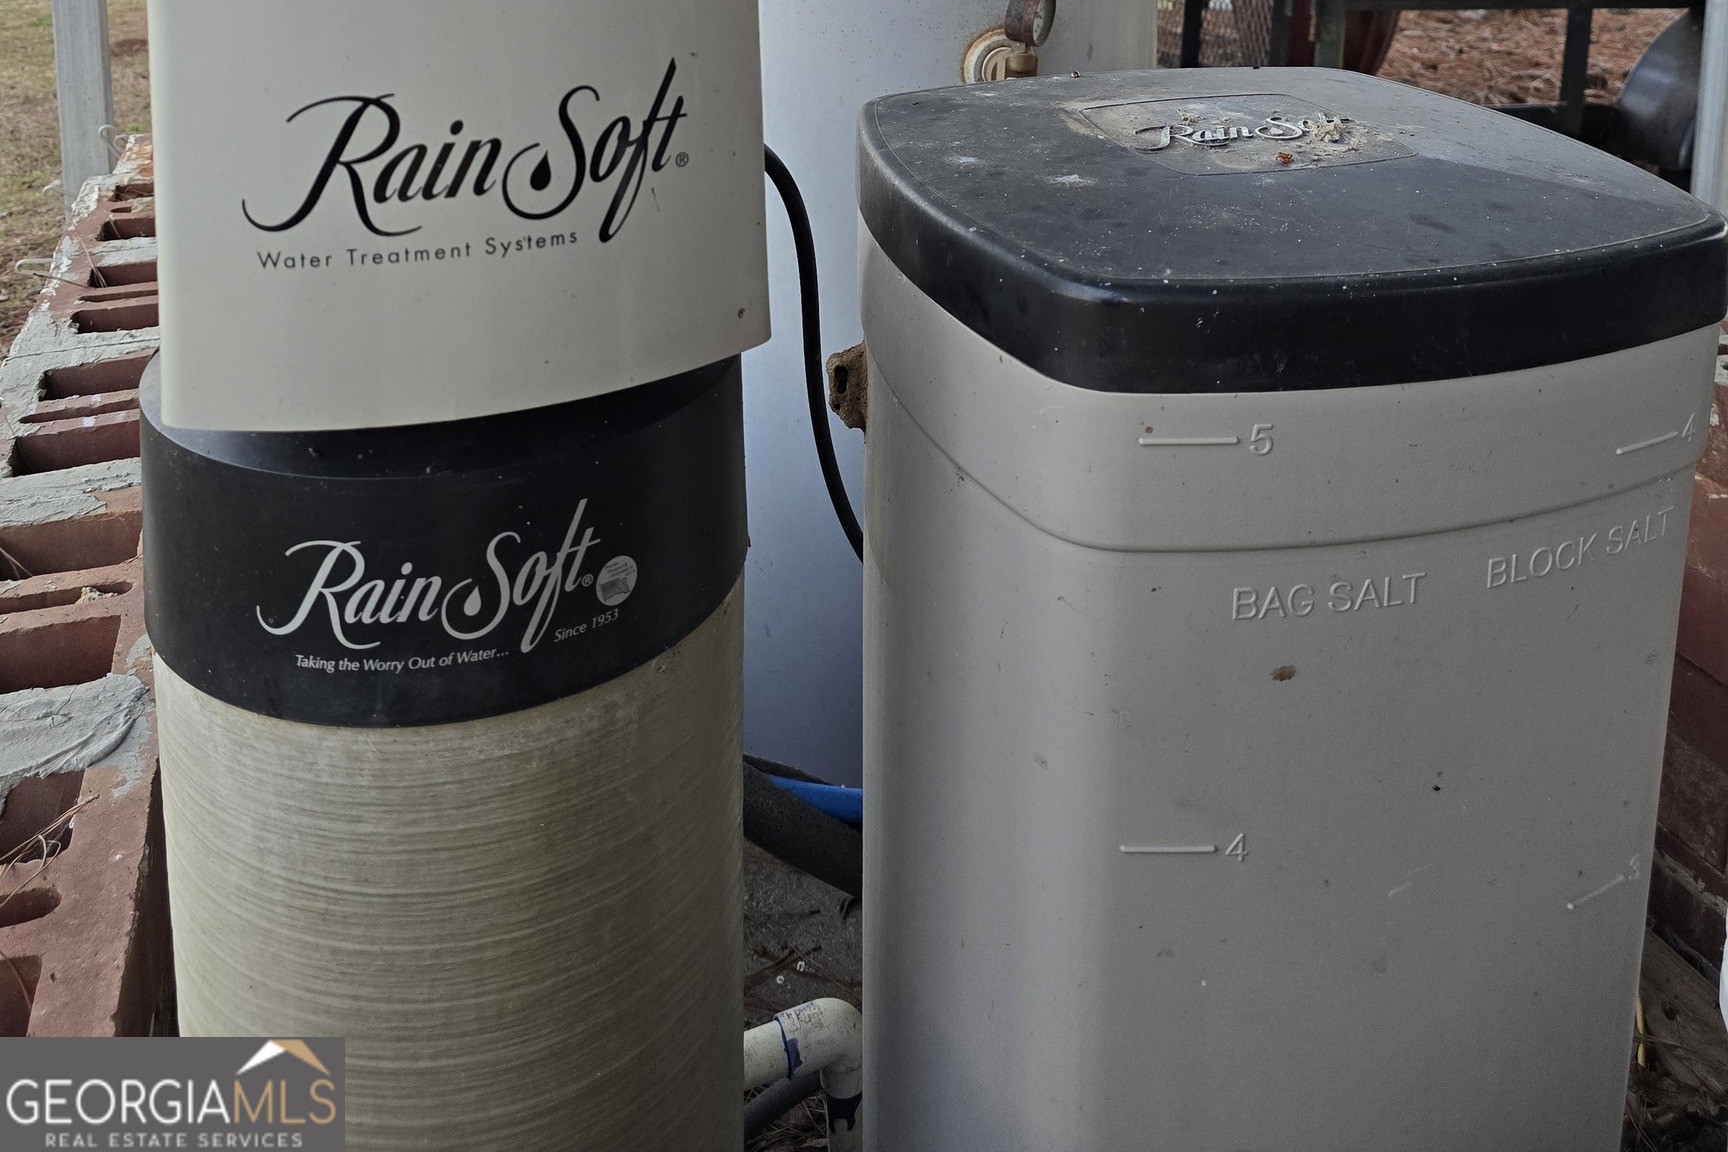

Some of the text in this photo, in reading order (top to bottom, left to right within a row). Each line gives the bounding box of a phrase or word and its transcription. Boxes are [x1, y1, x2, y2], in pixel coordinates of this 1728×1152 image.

[257, 230, 578, 269] Water Treatment Systems
[1249, 423, 1274, 456] 5
[1681, 412, 1698, 442] 4
[1486, 505, 1676, 589] BLOCK SALT
[1231, 571, 1427, 621] BAG SALT
[553, 608, 620, 643] Since 1953
[295, 654, 335, 674] Taking
[338, 657, 360, 672] the
[362, 657, 404, 674] Worry
[408, 656, 436, 671] Out
[438, 651, 455, 667] of
[1224, 832, 1249, 863] 4
